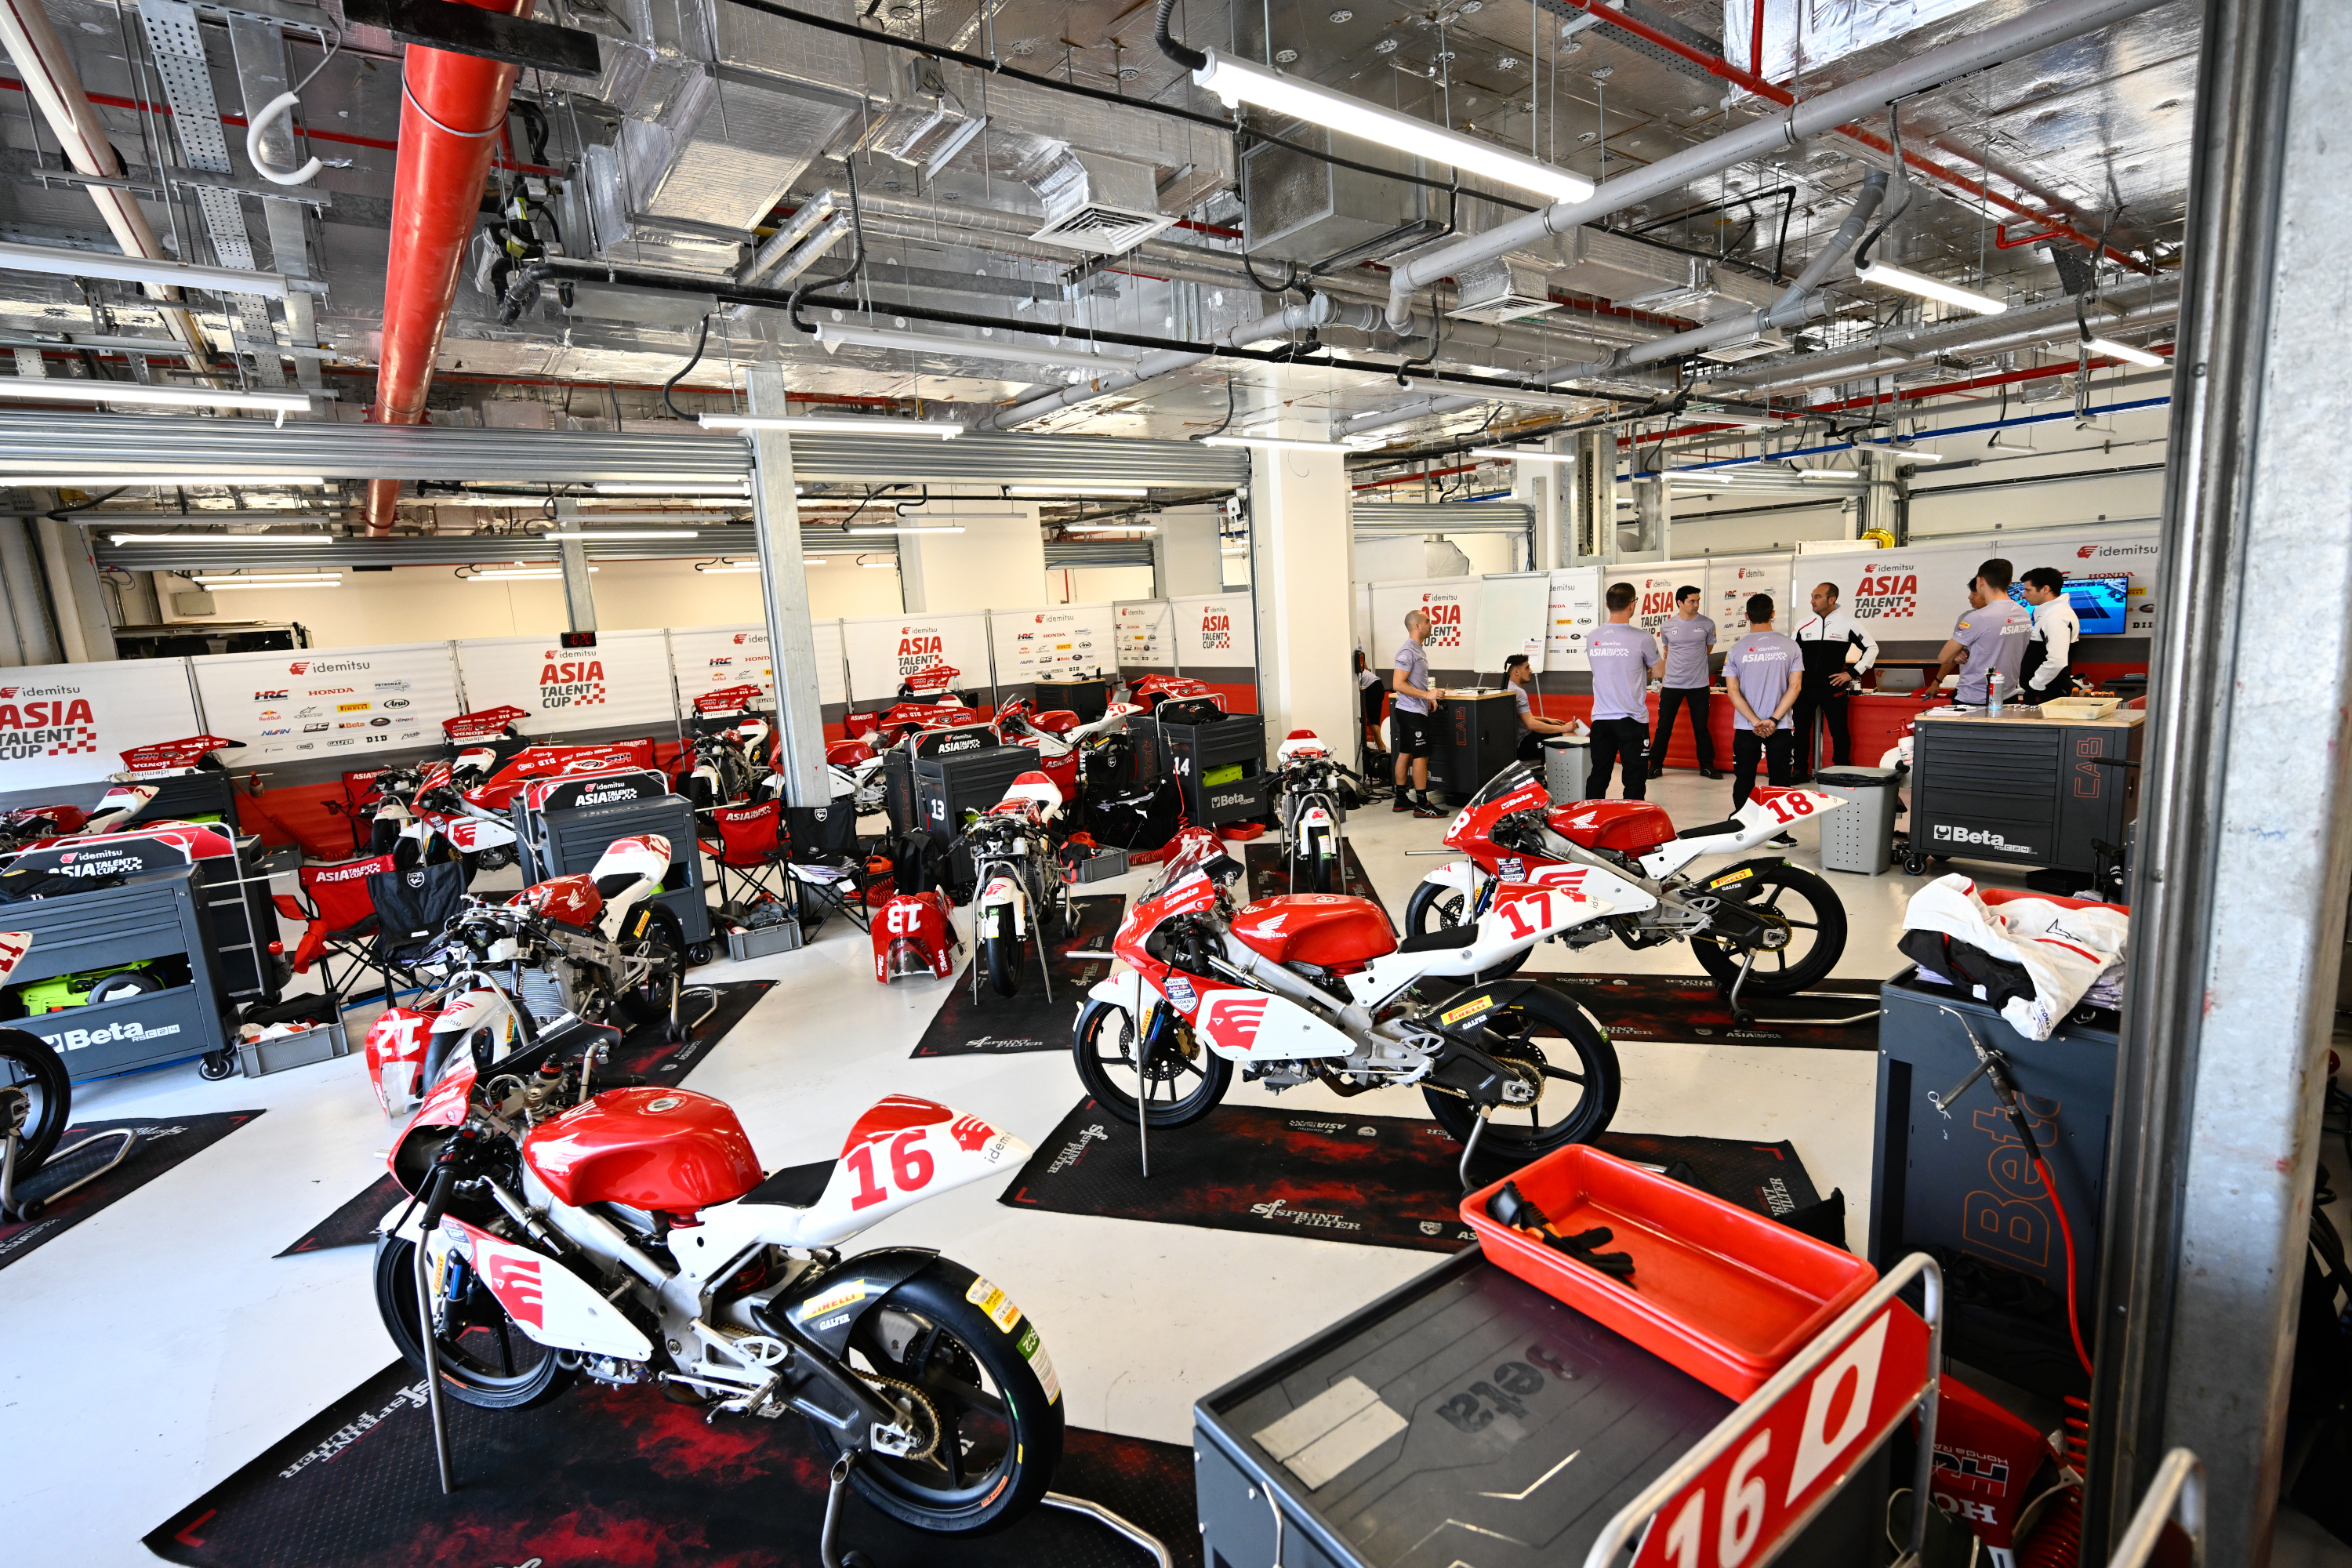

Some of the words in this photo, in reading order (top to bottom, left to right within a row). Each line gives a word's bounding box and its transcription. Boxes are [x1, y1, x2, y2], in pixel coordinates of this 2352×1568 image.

[1940, 76, 1964, 87] WATER
[2100, 544, 2158, 557] idemitsu
[1745, 569, 1766, 579] idemitsu
[1878, 563, 1914, 572] idemitsu
[1653, 579, 1672, 588] idemitsu
[1855, 575, 1917, 597] ASIA
[1432, 593, 1457, 602] idemitsu
[1641, 591, 1674, 615] ASIA
[1854, 597, 1904, 608] TALENT
[1046, 614, 1074, 622] idemitsu
[1127, 608, 1145, 616] idemitsu
[1854, 608, 1882, 619] CUP
[1202, 615, 1230, 632] ASIA
[1640, 615, 1668, 628] TALENT
[1202, 632, 1225, 641] TALENT
[1999, 626, 2020, 636] ASIA
[898, 636, 942, 656] ASIA
[1203, 641, 1215, 649] CUP
[559, 650, 597, 659] idemitsu
[1589, 648, 1607, 657] ASIA
[1742, 653, 1765, 663] ASIA
[312, 660, 370, 673] idemitsu
[709, 657, 732, 666] HRC
[898, 655, 934, 666] TALENT
[539, 660, 604, 685] ASIA
[899, 666, 919, 676] CUP
[22, 685, 81, 697] idemitsu
[254, 689, 289, 700] HRC
[307, 687, 355, 696] HONDA
[539, 683, 593, 697] TALENT
[340, 703, 368, 712] PIRELLI
[543, 696, 571, 709] CUP
[0, 699, 94, 731] ASIA
[1456, 706, 1467, 746] CAB
[0, 745, 43, 760] CUP
[938, 742, 960, 754] ASIA
[132, 760, 171, 769] HONDA
[1173, 757, 1190, 776] 14
[2074, 737, 2103, 798] CAB
[596, 781, 626, 790] idemitsu
[575, 791, 608, 807] ASIA
[607, 788, 632, 797] TALENT
[1220, 793, 1244, 807] Beta
[1508, 793, 1534, 807] Beta
[726, 811, 751, 822] ASIA
[750, 806, 768, 815] TALENT
[931, 798, 946, 822] 13
[1766, 792, 1815, 825] 18
[1952, 826, 2005, 847] Beta
[78, 848, 123, 862] idemitsu
[95, 857, 132, 869] TALENT
[96, 866, 118, 875] CUP
[316, 869, 350, 883] ASIA
[347, 864, 375, 874] TALENT
[1715, 872, 1748, 887] PIRELLI
[1722, 883, 1742, 891] GALFER
[1174, 886, 1200, 904] Beta
[570, 901, 586, 913] HONDA
[1501, 891, 1552, 941] 17
[636, 913, 649, 934] PIRELLI
[1447, 999, 1486, 1022] PIRELLI
[2037, 1000, 2051, 1029] PETRONAS
[1141, 1008, 1152, 1037] PIRELLI
[1462, 1014, 1488, 1030] GALFER
[64, 1022, 145, 1051] Beta
[1068, 1133, 1093, 1167] SPRINT
[1047, 1142, 1079, 1174] FILTER
[535, 1160, 570, 1173] HONDA
[846, 1127, 935, 1212] 16
[1273, 1208, 1344, 1223] SPRINT
[1292, 1218, 1362, 1232] FILTER
[434, 1254, 445, 1291] PIRELLI
[811, 1292, 856, 1315] PIRELLI
[819, 1313, 851, 1330] GALFER
[320, 1396, 408, 1463] SPRINT
[278, 1411, 373, 1479] FILTER
[1955, 1447, 2009, 1466] Honda
[1664, 1428, 1772, 1568] 16
